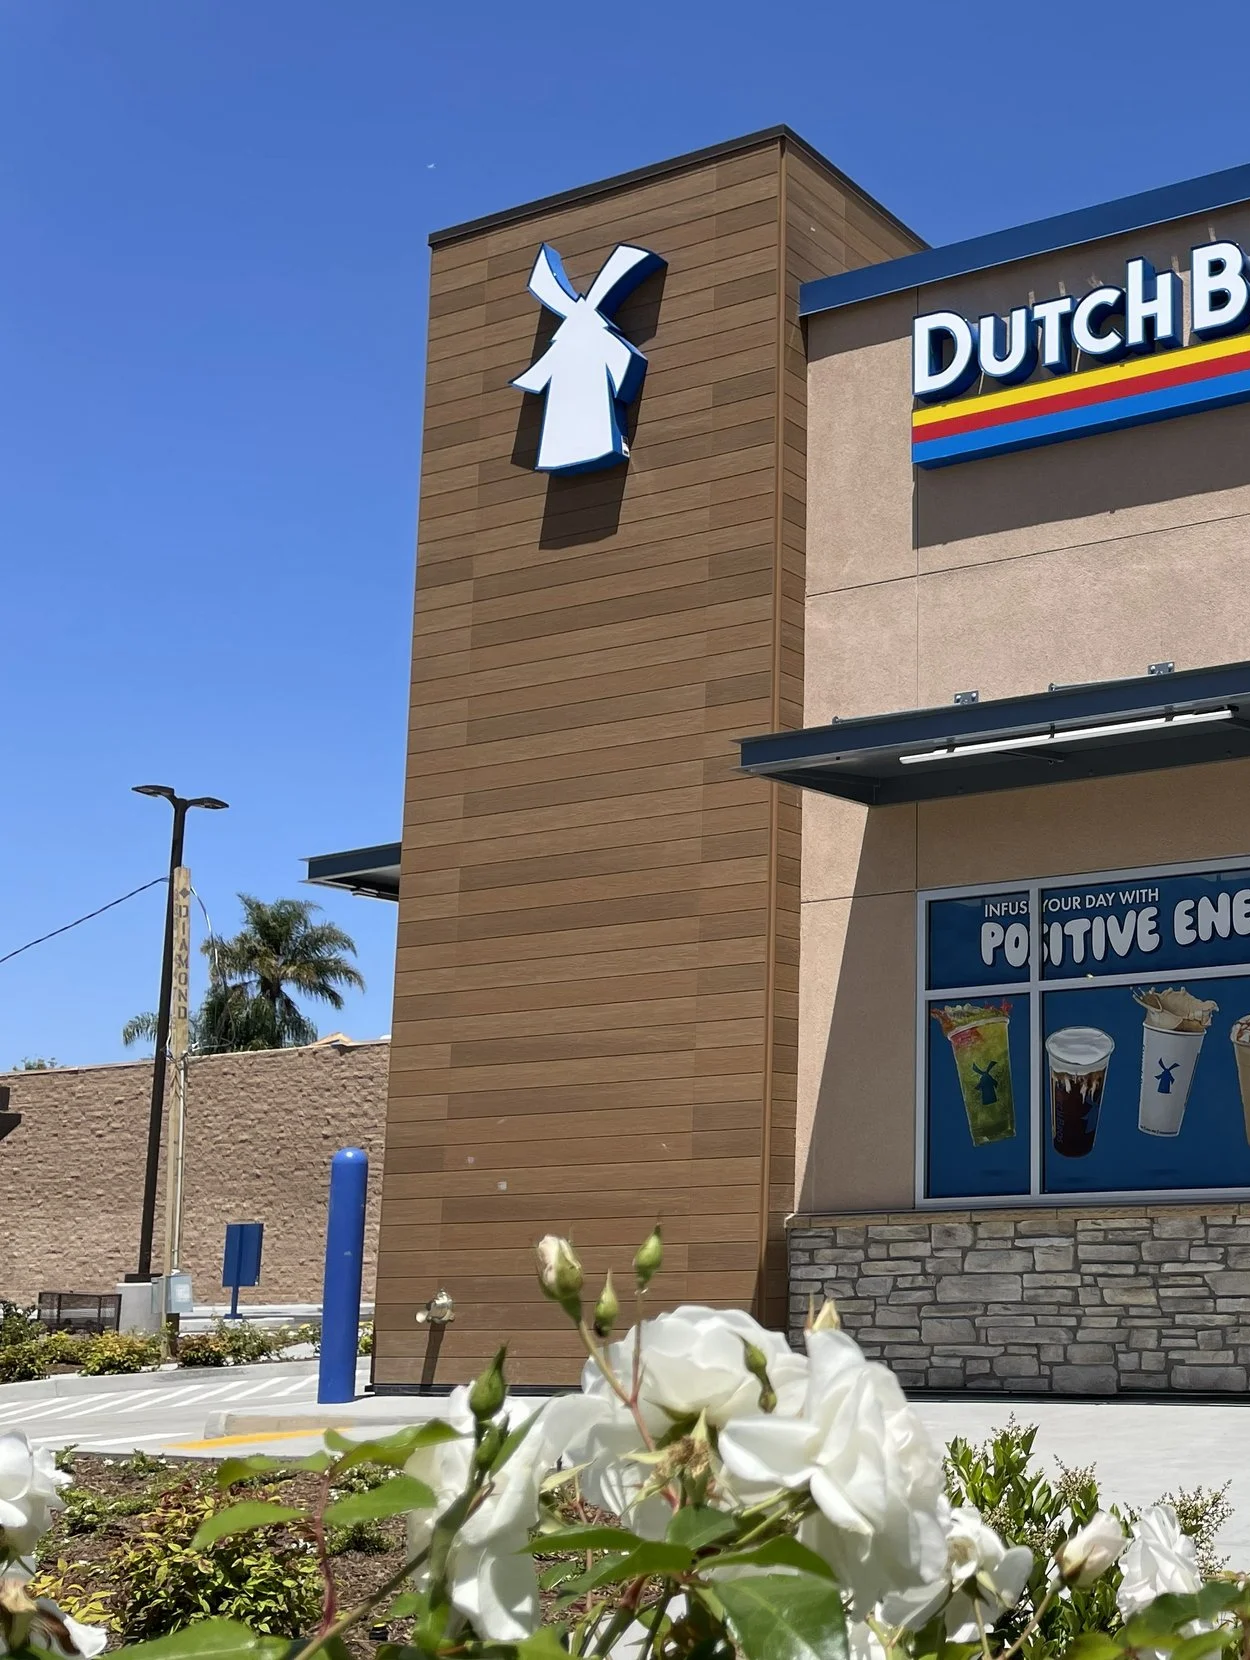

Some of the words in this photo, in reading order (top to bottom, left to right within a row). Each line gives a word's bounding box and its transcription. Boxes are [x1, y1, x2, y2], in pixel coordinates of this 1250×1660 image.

[1085, 892, 1115, 909] DAY
[1119, 887, 1159, 905] WITH
[176, 904, 189, 1020] DIAMOND
